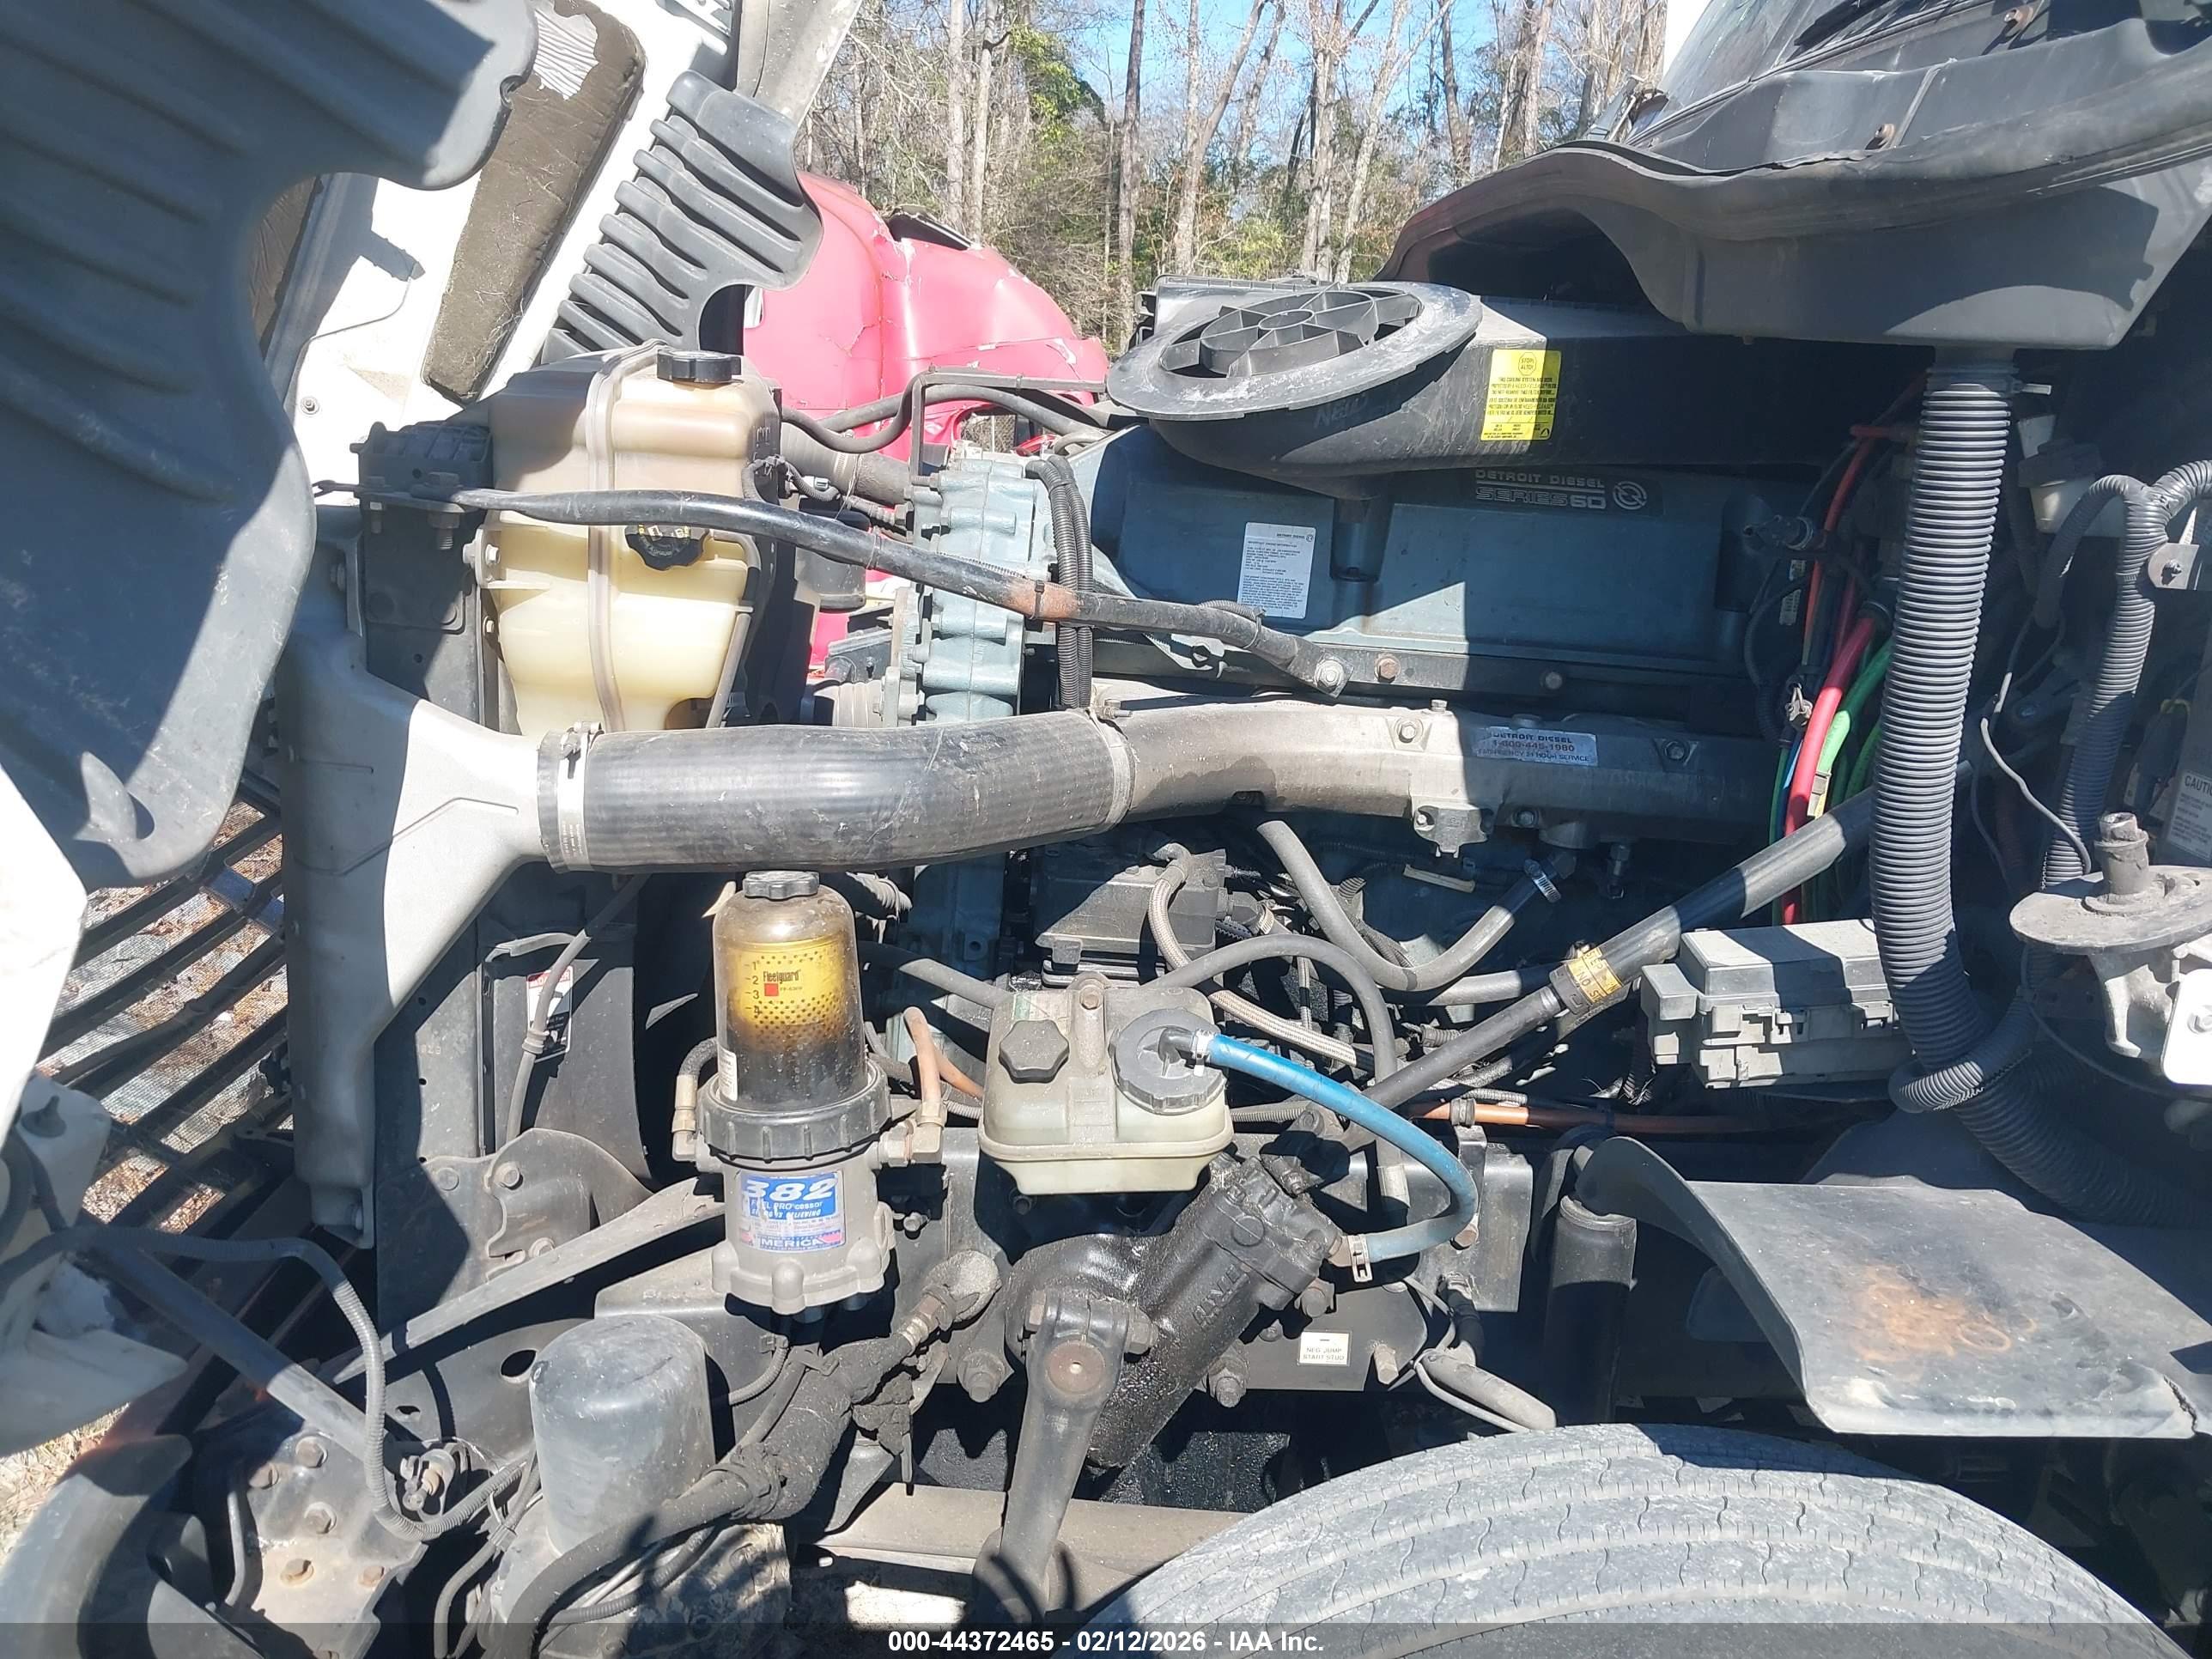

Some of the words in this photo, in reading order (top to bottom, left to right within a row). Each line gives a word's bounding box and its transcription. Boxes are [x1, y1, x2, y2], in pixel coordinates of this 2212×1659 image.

[1475, 470, 1541, 483] DETROIT
[1549, 475, 1605, 489] DIESEL
[1476, 486, 1568, 507] SERIES
[1570, 495, 1607, 509] 60
[1538, 734, 1572, 744] DIESEL
[1559, 753, 1589, 762] SERVICE
[752, 975, 759, 985] 2
[763, 969, 799, 984] Fleetguard
[752, 989, 760, 1000] 3
[746, 1177, 838, 1201] 382
